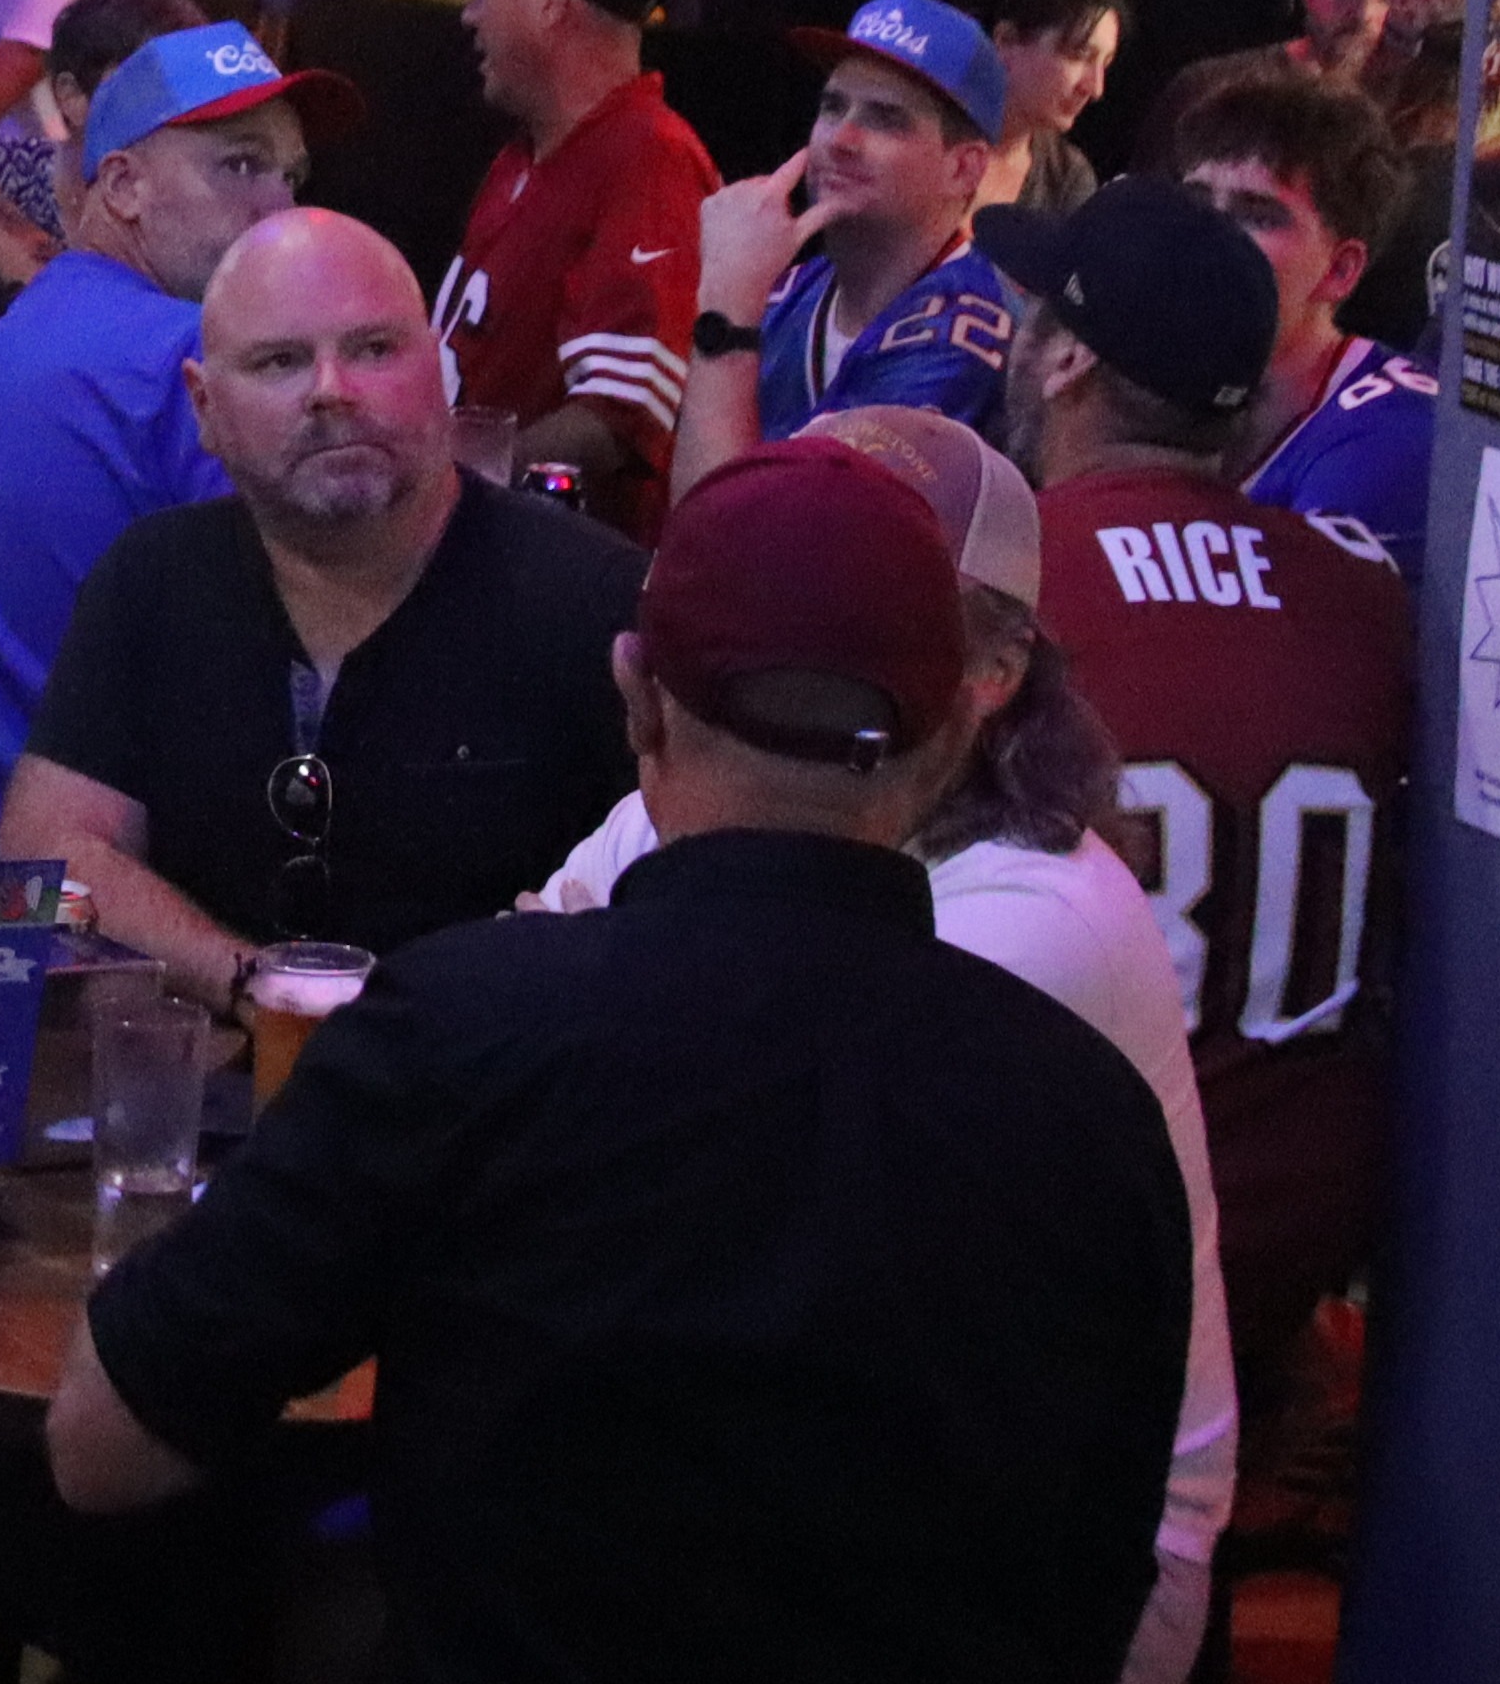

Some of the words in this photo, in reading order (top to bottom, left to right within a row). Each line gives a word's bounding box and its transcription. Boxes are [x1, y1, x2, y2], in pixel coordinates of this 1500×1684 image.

[205, 42, 283, 77] Coo
[874, 291, 1014, 372] 22
[1095, 520, 1282, 610] RICE
